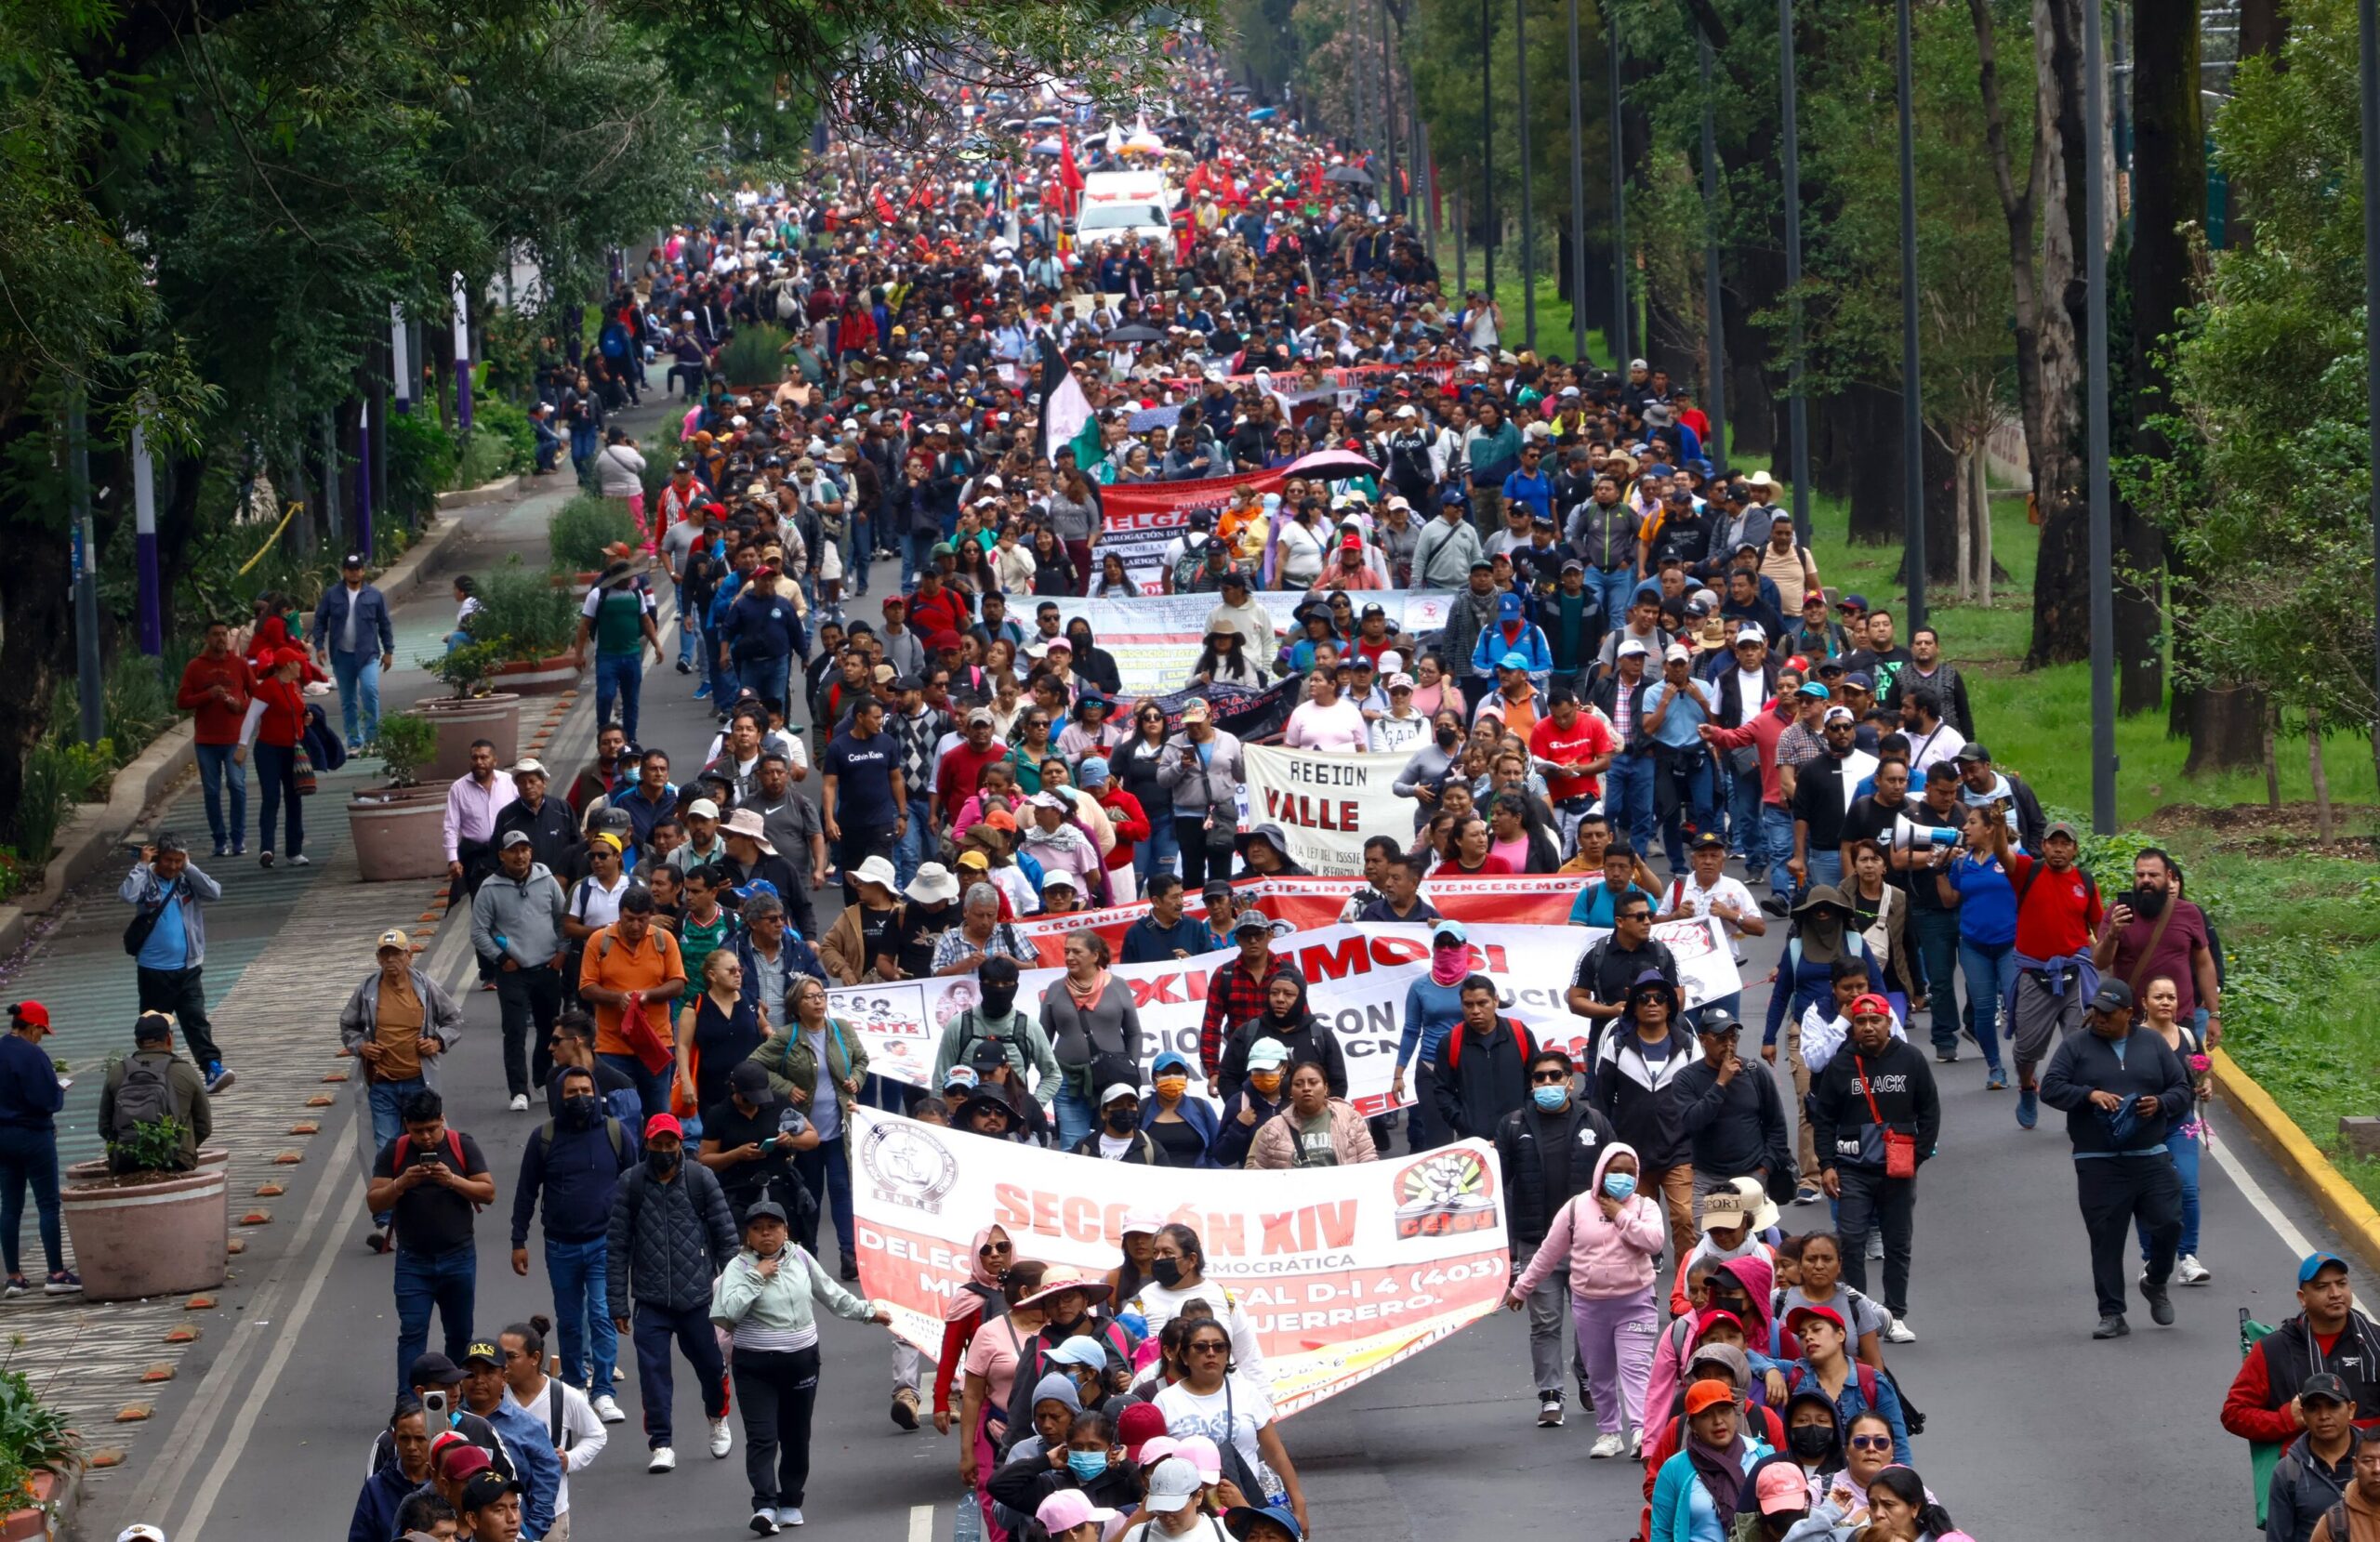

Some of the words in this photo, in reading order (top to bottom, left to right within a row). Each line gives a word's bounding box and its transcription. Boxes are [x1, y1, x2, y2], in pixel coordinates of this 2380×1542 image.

[1101, 529, 1161, 543] ABROGACIÓN
[848, 753, 868, 762] Calvin
[1291, 760, 1368, 786] REGIÓN
[1264, 786, 1359, 832] VALLE
[1037, 900, 1195, 932] ORGANIZAS
[994, 1181, 1246, 1257] SECCÓN
[1258, 1199, 1358, 1256] XIV
[1373, 1277, 1400, 1296] 4
[1409, 1256, 1504, 1294] (403)
[1251, 1293, 1444, 1334] UERRERO.
